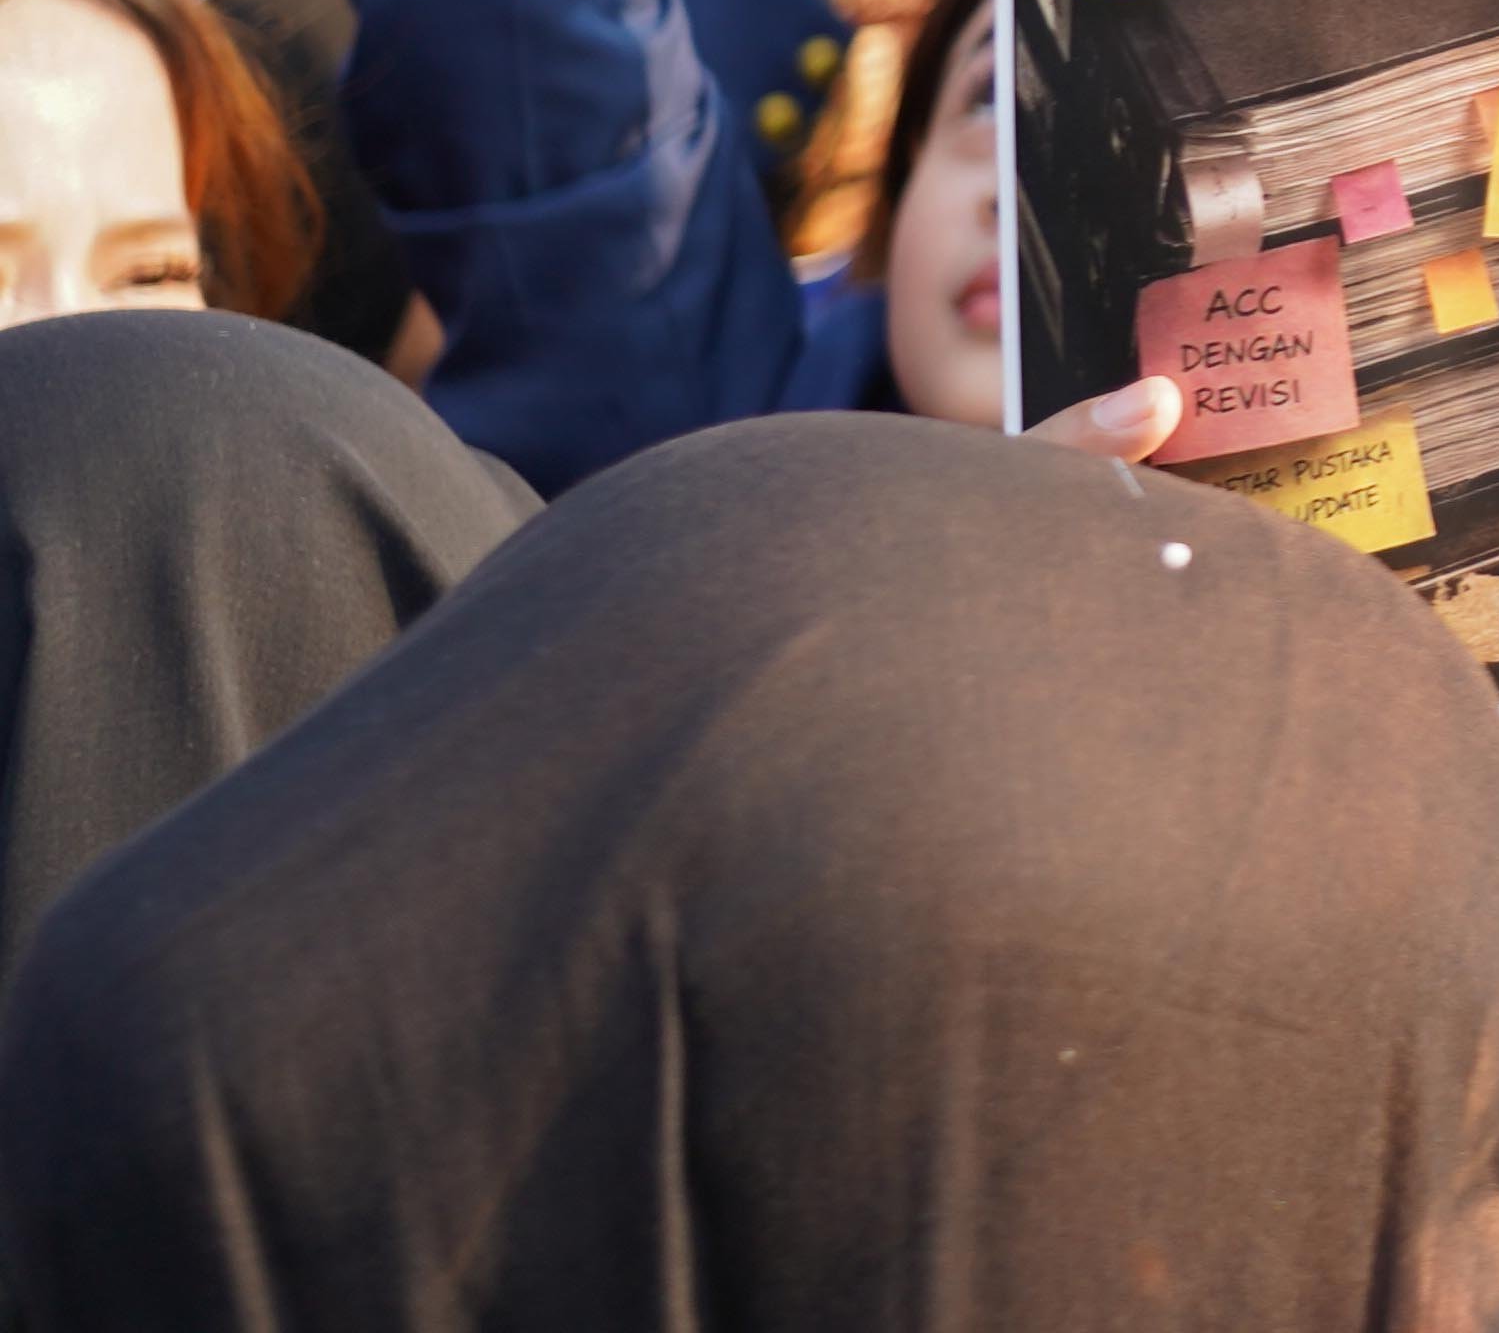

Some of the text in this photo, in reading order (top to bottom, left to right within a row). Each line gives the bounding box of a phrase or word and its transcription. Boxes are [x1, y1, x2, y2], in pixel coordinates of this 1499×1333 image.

[1204, 285, 1283, 322] ACC
[1179, 331, 1314, 374] DENGAN
[1193, 379, 1302, 420] REVISI
[1293, 441, 1393, 482] PUSTAKA
